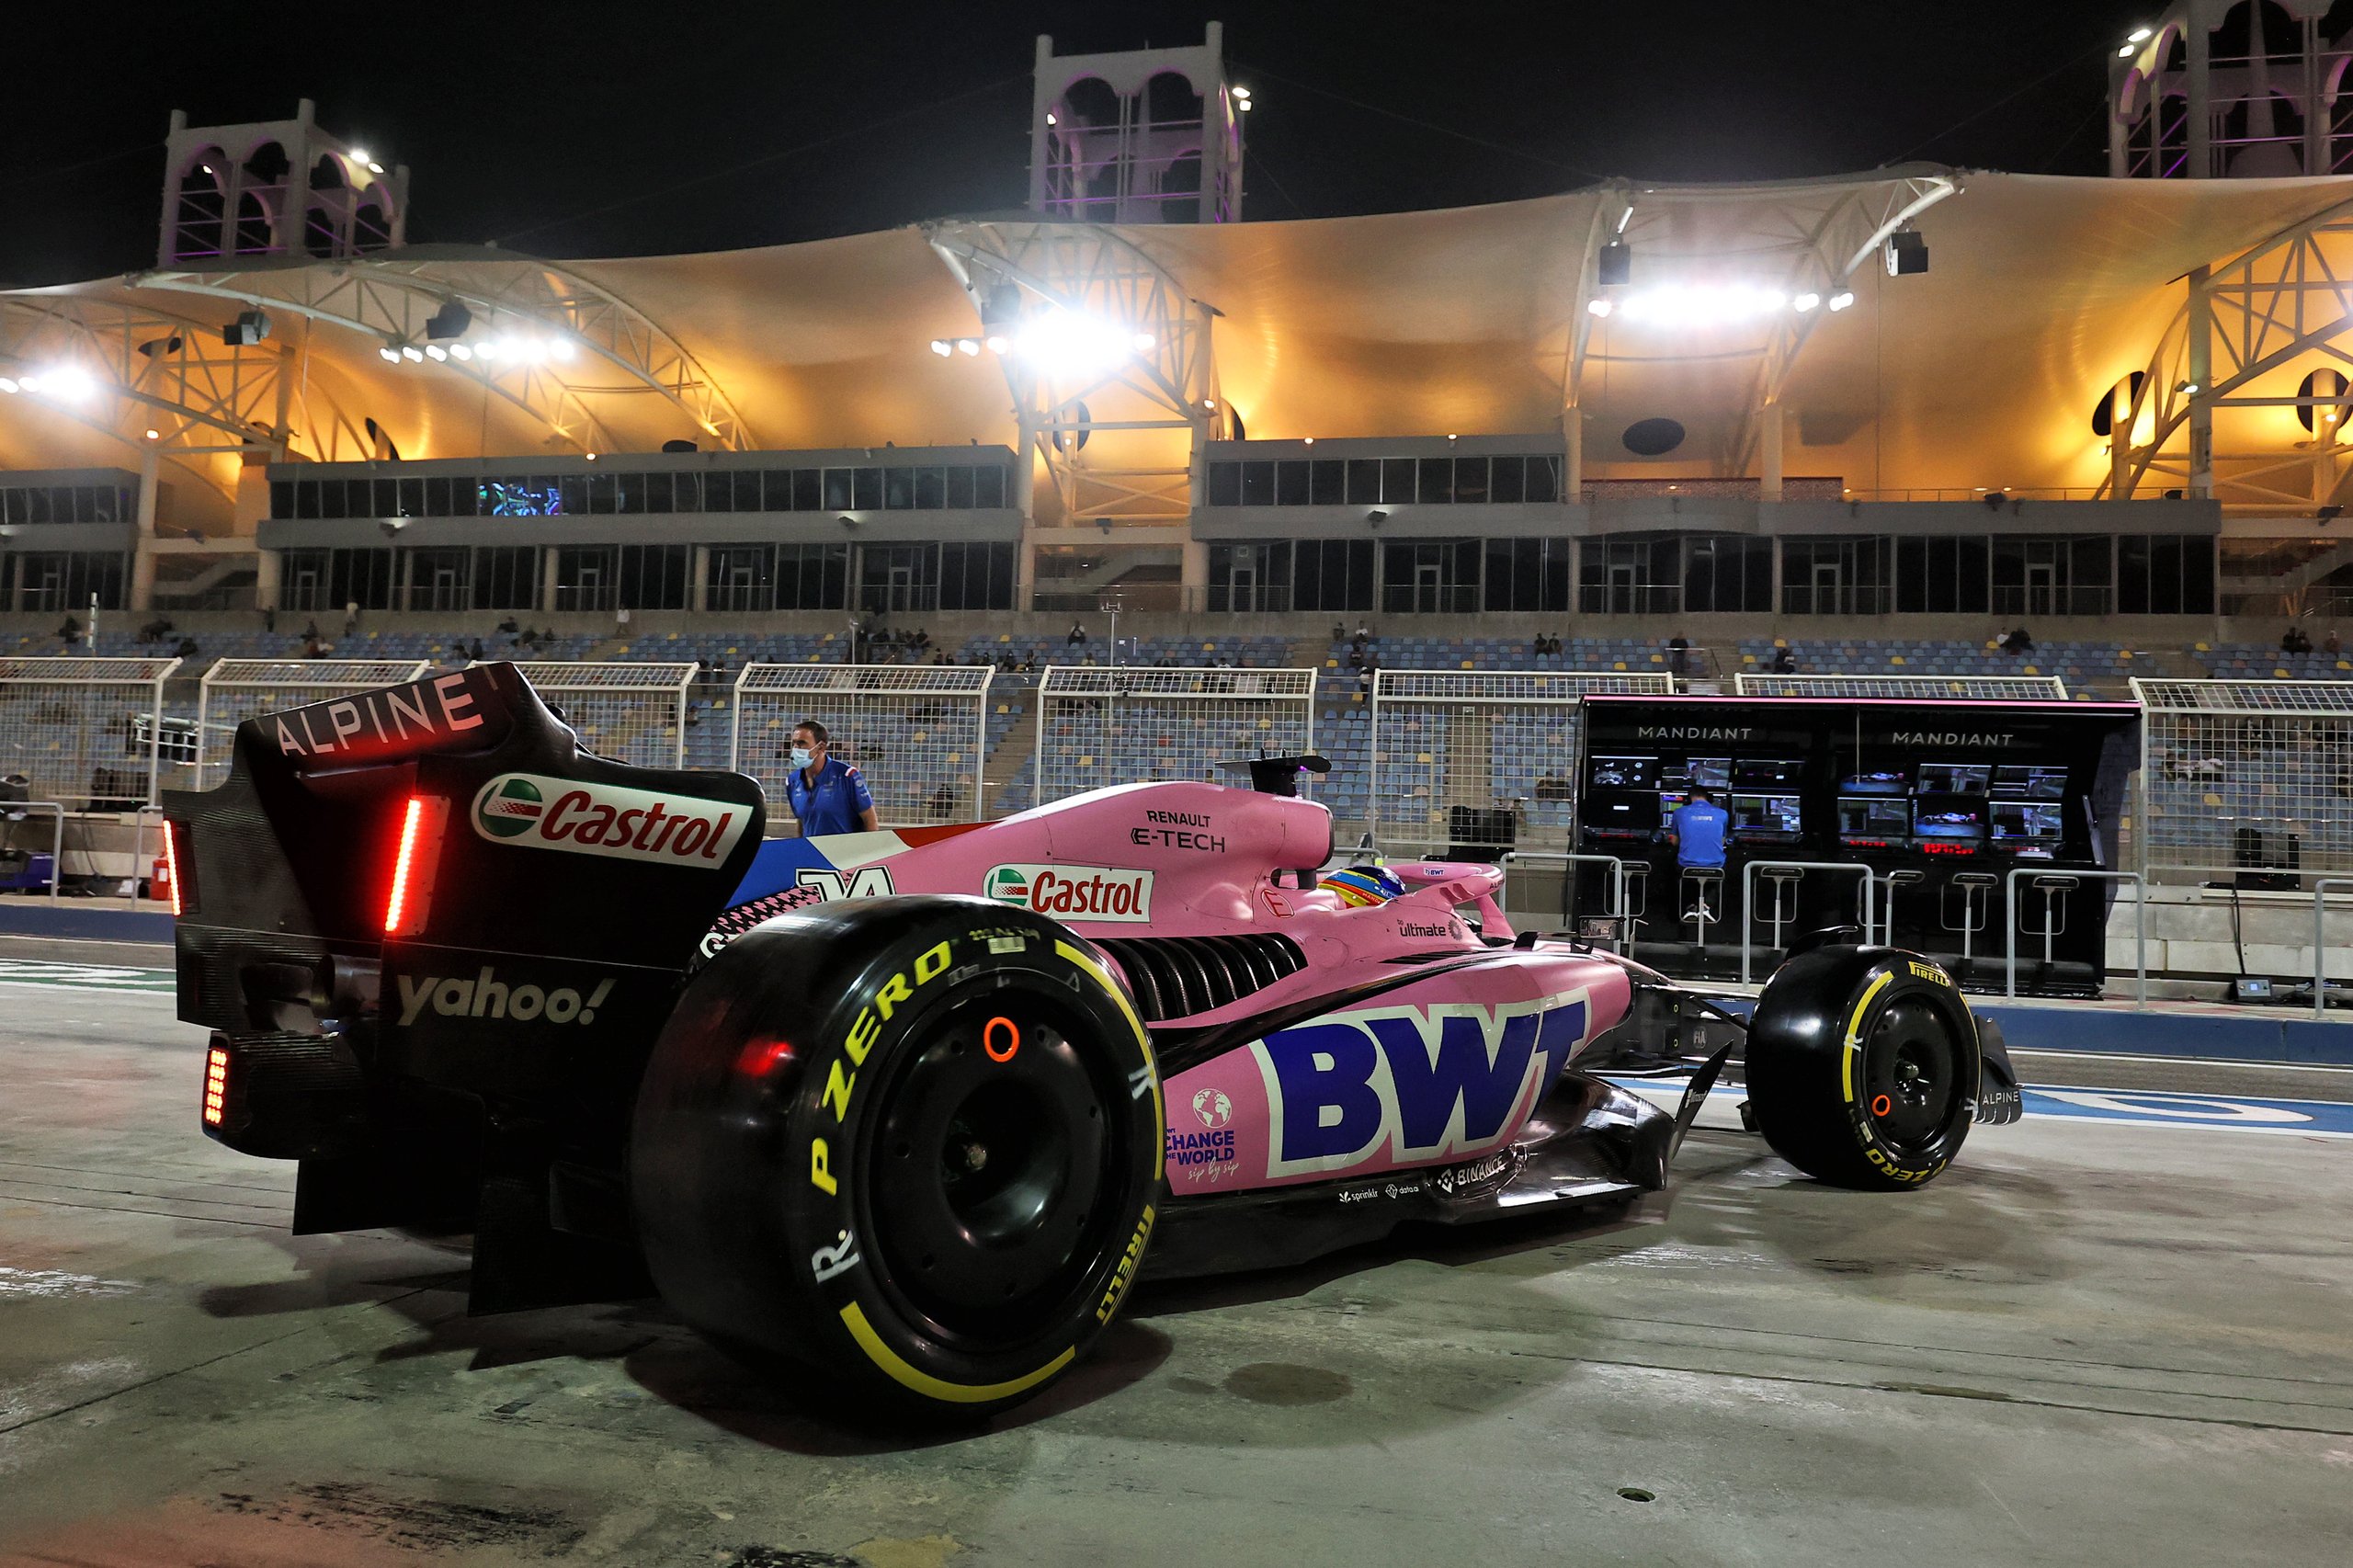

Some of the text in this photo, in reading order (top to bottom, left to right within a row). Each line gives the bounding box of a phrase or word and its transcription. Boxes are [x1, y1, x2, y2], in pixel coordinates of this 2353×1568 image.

[277, 673, 483, 757] ALPINE
[1638, 726, 1752, 740] MANDIANT
[1893, 732, 2014, 746] MANDIANT
[540, 789, 733, 860] Castrol
[1146, 810, 1211, 828] RENAULT
[1131, 827, 1225, 853] E-TECH
[1031, 871, 1142, 915] Castrol
[1400, 923, 1447, 937] ultimate
[1908, 960, 1950, 987] PIRELLI
[397, 966, 617, 1027] yahoo!
[812, 939, 954, 1196] P ZERO
[1263, 1000, 1586, 1161] BWT
[1983, 1091, 2019, 1106] ALPINE
[1177, 1148, 1234, 1165] WORLD
[1188, 1156, 1239, 1183] sip by sip
[1458, 1154, 1504, 1186] BINANCE
[1865, 1149, 1930, 1182] ZERO
[1351, 1187, 1379, 1202] sprinklr
[1096, 1204, 1155, 1325] PIRELLI
